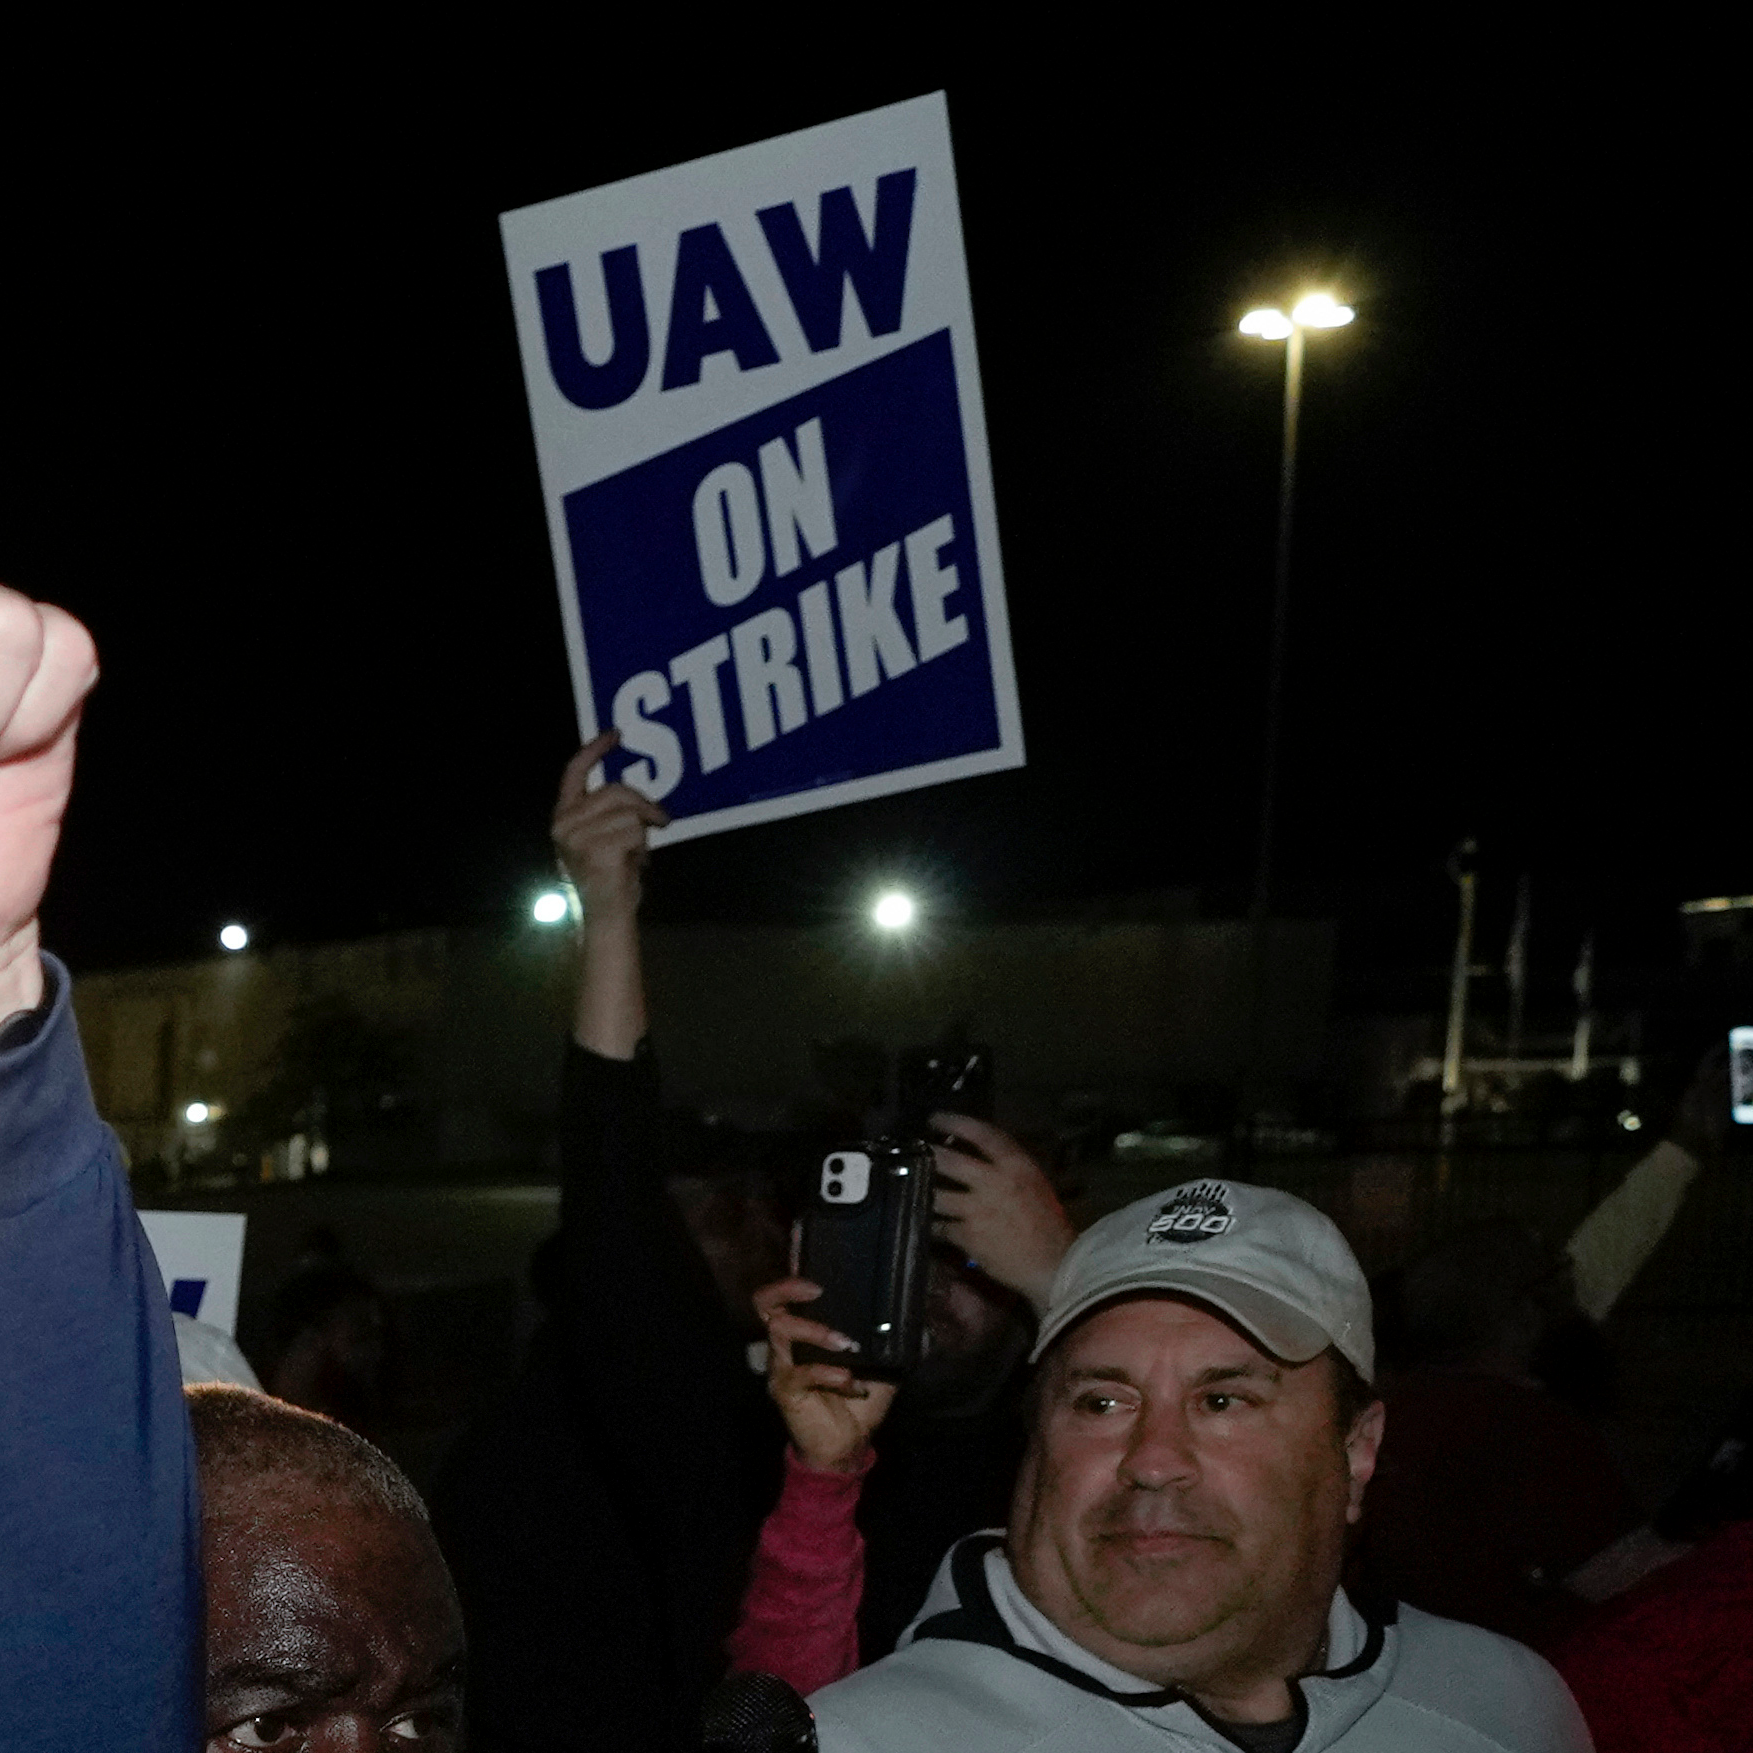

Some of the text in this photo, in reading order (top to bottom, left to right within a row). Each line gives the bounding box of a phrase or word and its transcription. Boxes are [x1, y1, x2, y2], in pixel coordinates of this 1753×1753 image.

[534, 166, 918, 412] UAW
[692, 416, 838, 607] ON
[611, 512, 970, 802] STRIKE
[1148, 1213, 1230, 1234] 500
